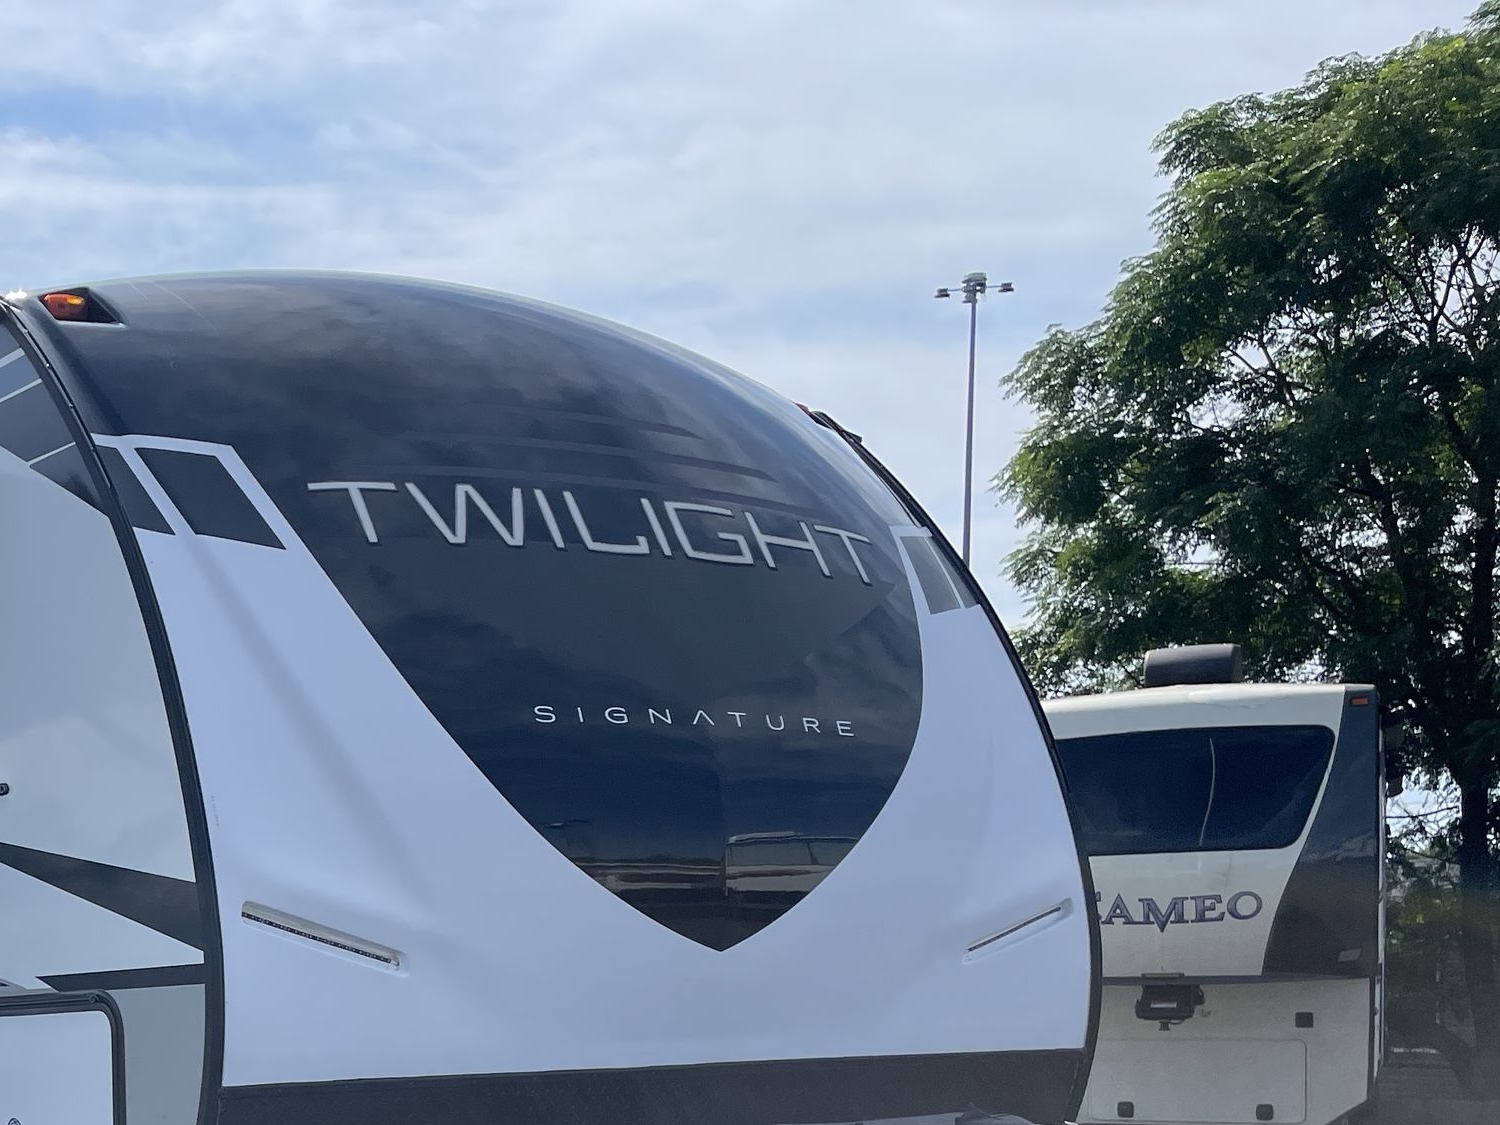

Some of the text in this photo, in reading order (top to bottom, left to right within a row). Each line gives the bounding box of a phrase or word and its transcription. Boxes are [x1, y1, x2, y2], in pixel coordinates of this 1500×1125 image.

[307, 481, 873, 586] TWILIGHT
[533, 704, 856, 737] SIGNATURE
[1095, 890, 1263, 934] AMEO
